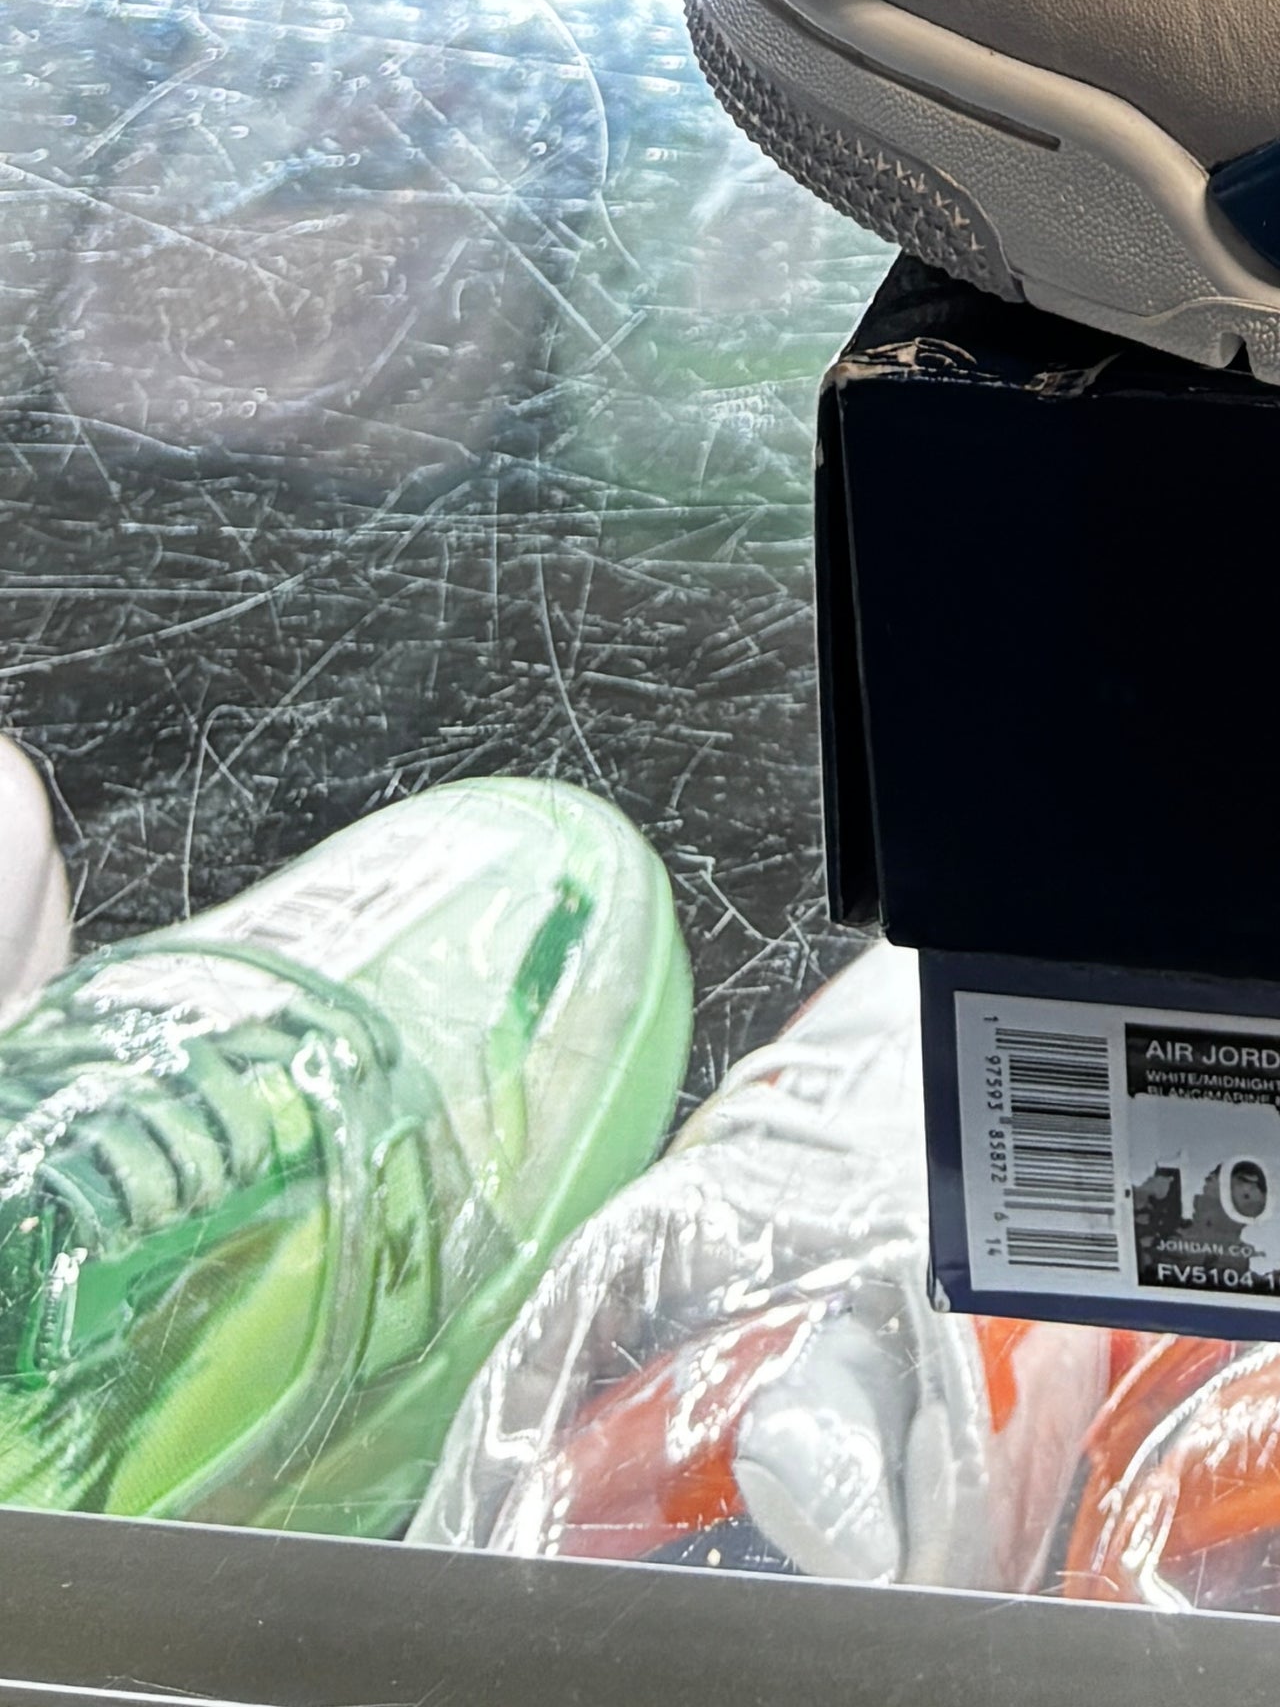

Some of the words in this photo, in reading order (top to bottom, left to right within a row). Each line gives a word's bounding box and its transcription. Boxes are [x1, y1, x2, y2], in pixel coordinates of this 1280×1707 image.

[1145, 1040, 1193, 1062] AIR
[985, 1055, 1004, 1111] 97593
[987, 1130, 1008, 1184] 85872
[1156, 1239, 1224, 1256] JORDAN
